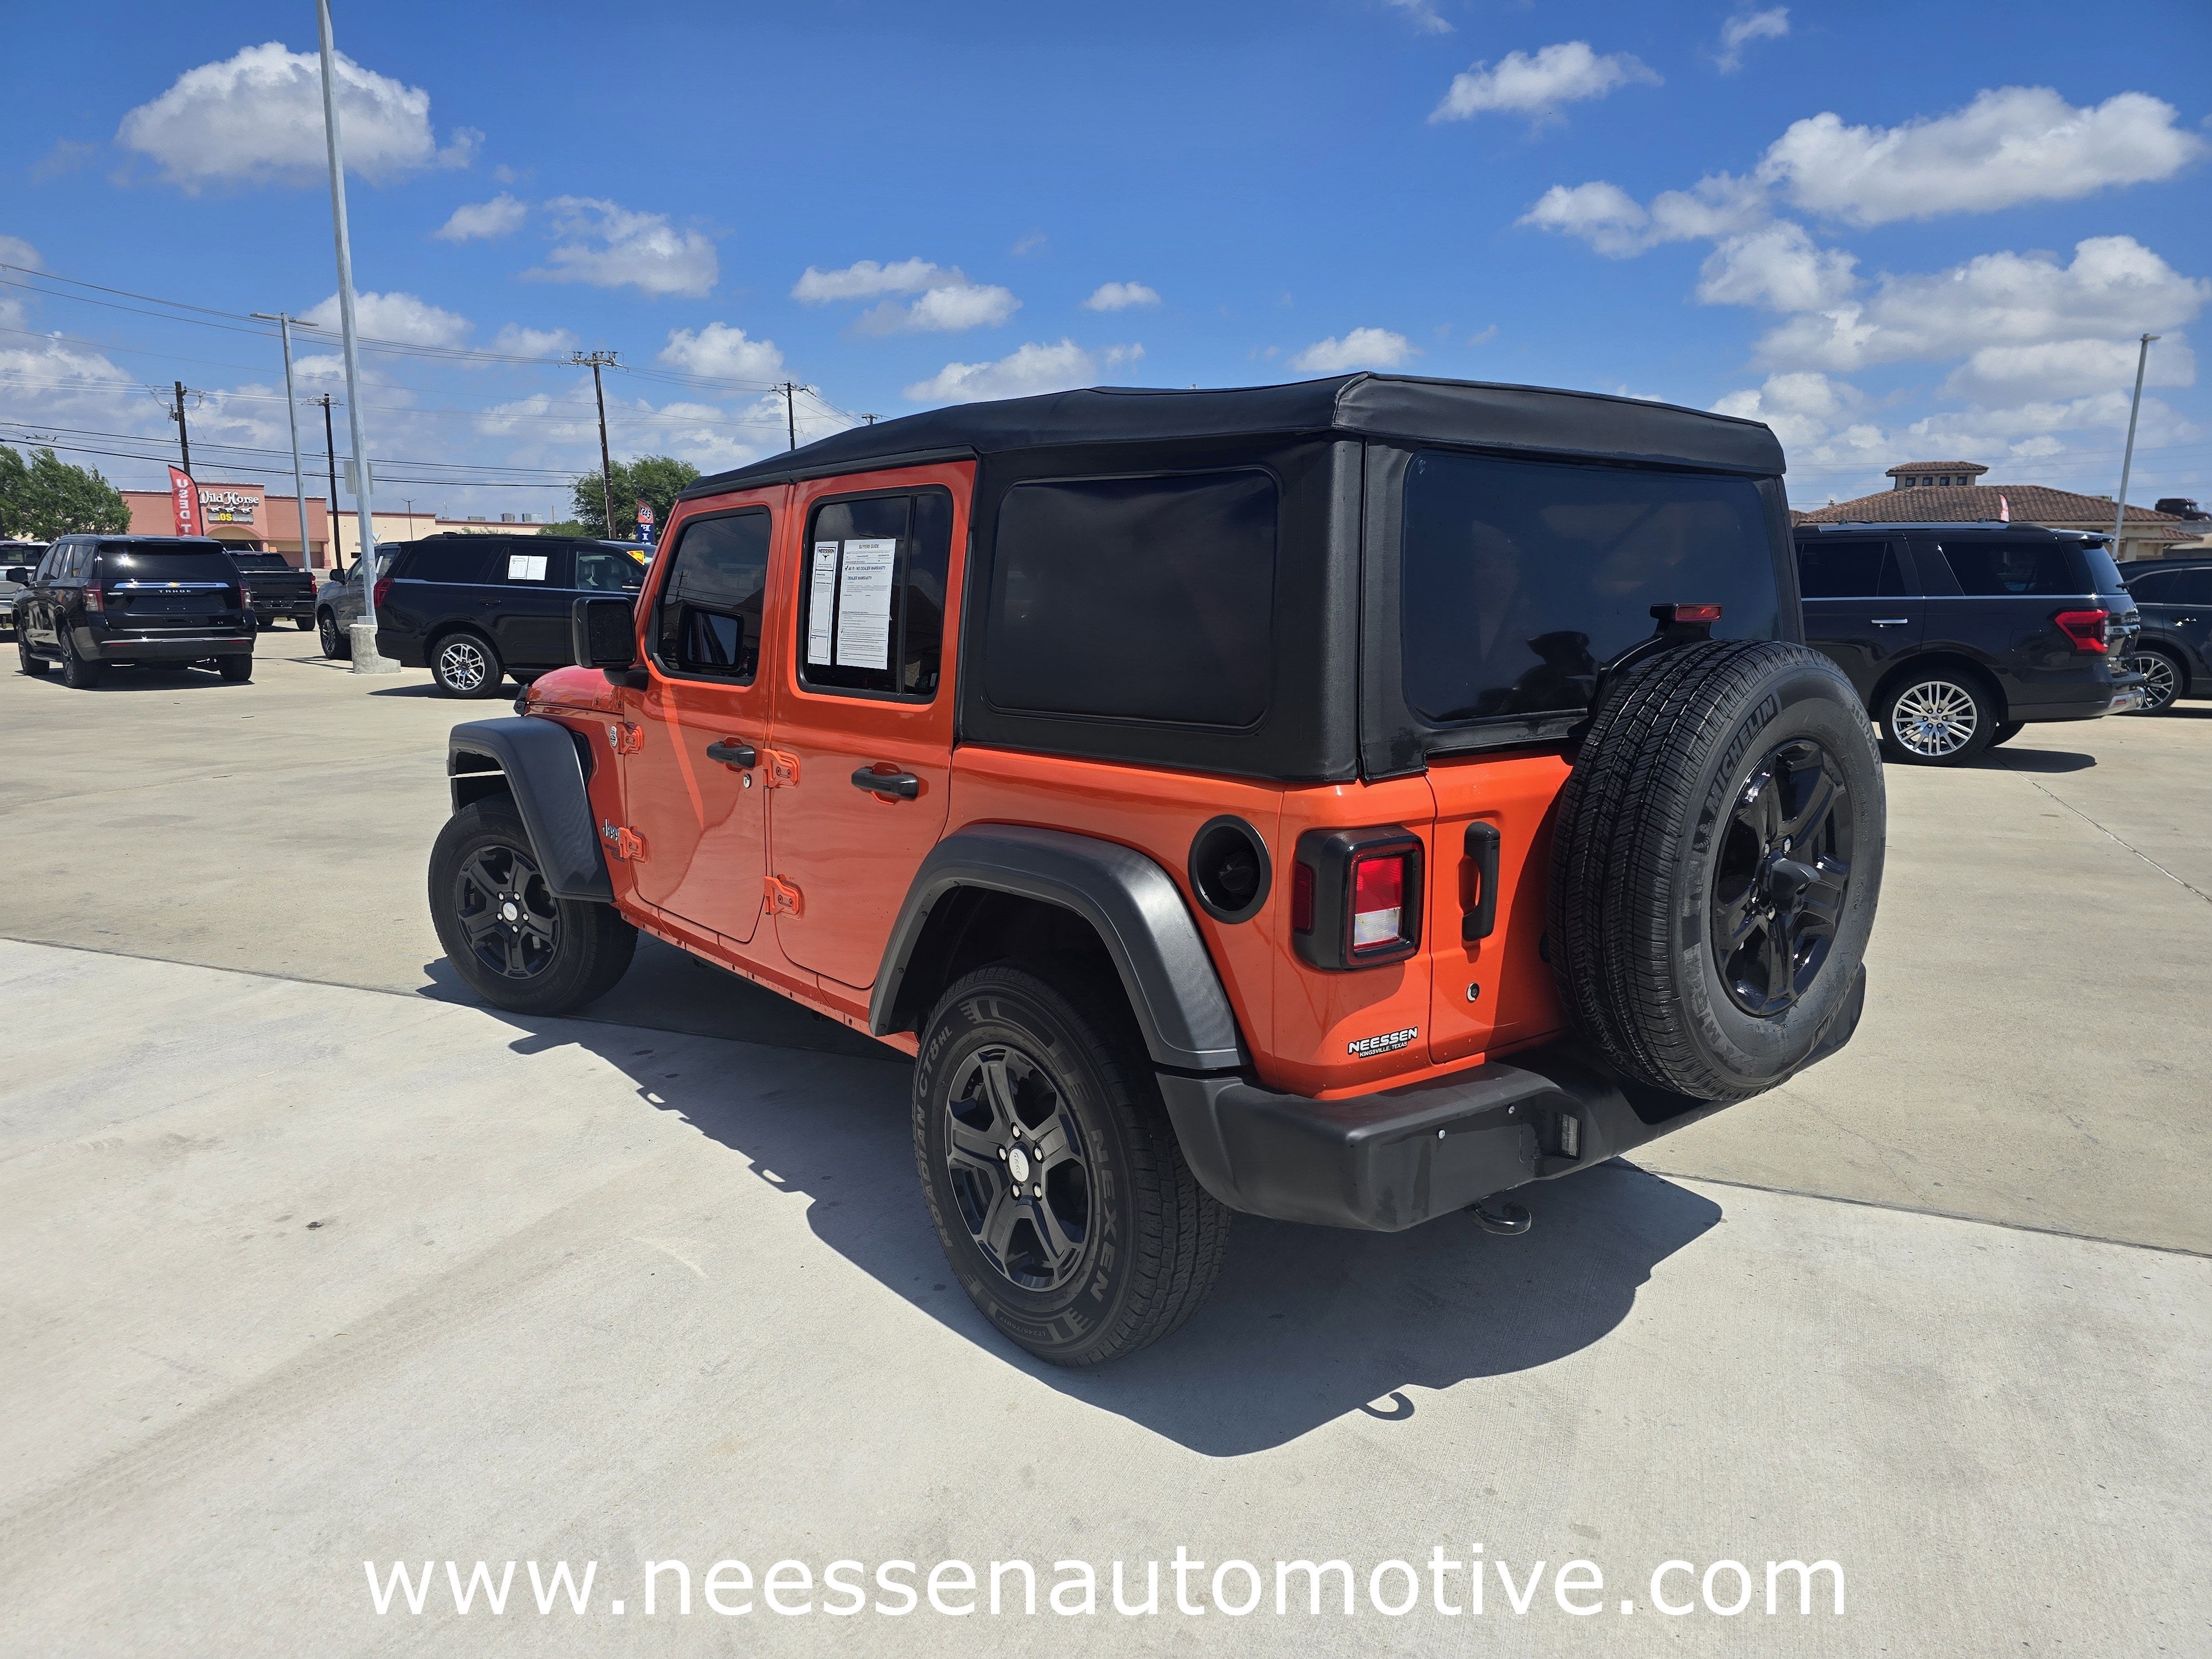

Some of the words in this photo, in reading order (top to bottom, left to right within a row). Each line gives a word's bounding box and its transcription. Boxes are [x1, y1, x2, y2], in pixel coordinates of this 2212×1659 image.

[199, 489, 224, 504] Wild
[224, 491, 259, 504] Horse
[1705, 695, 1775, 817] MICHELIN
[602, 818, 620, 841] Jee
[1348, 1027, 1417, 1053] NEESSEN
[1392, 1041, 1407, 1050] TEXAS
[917, 1104, 954, 1247] ROADIAN
[1090, 1129, 1117, 1302] NEXEN
